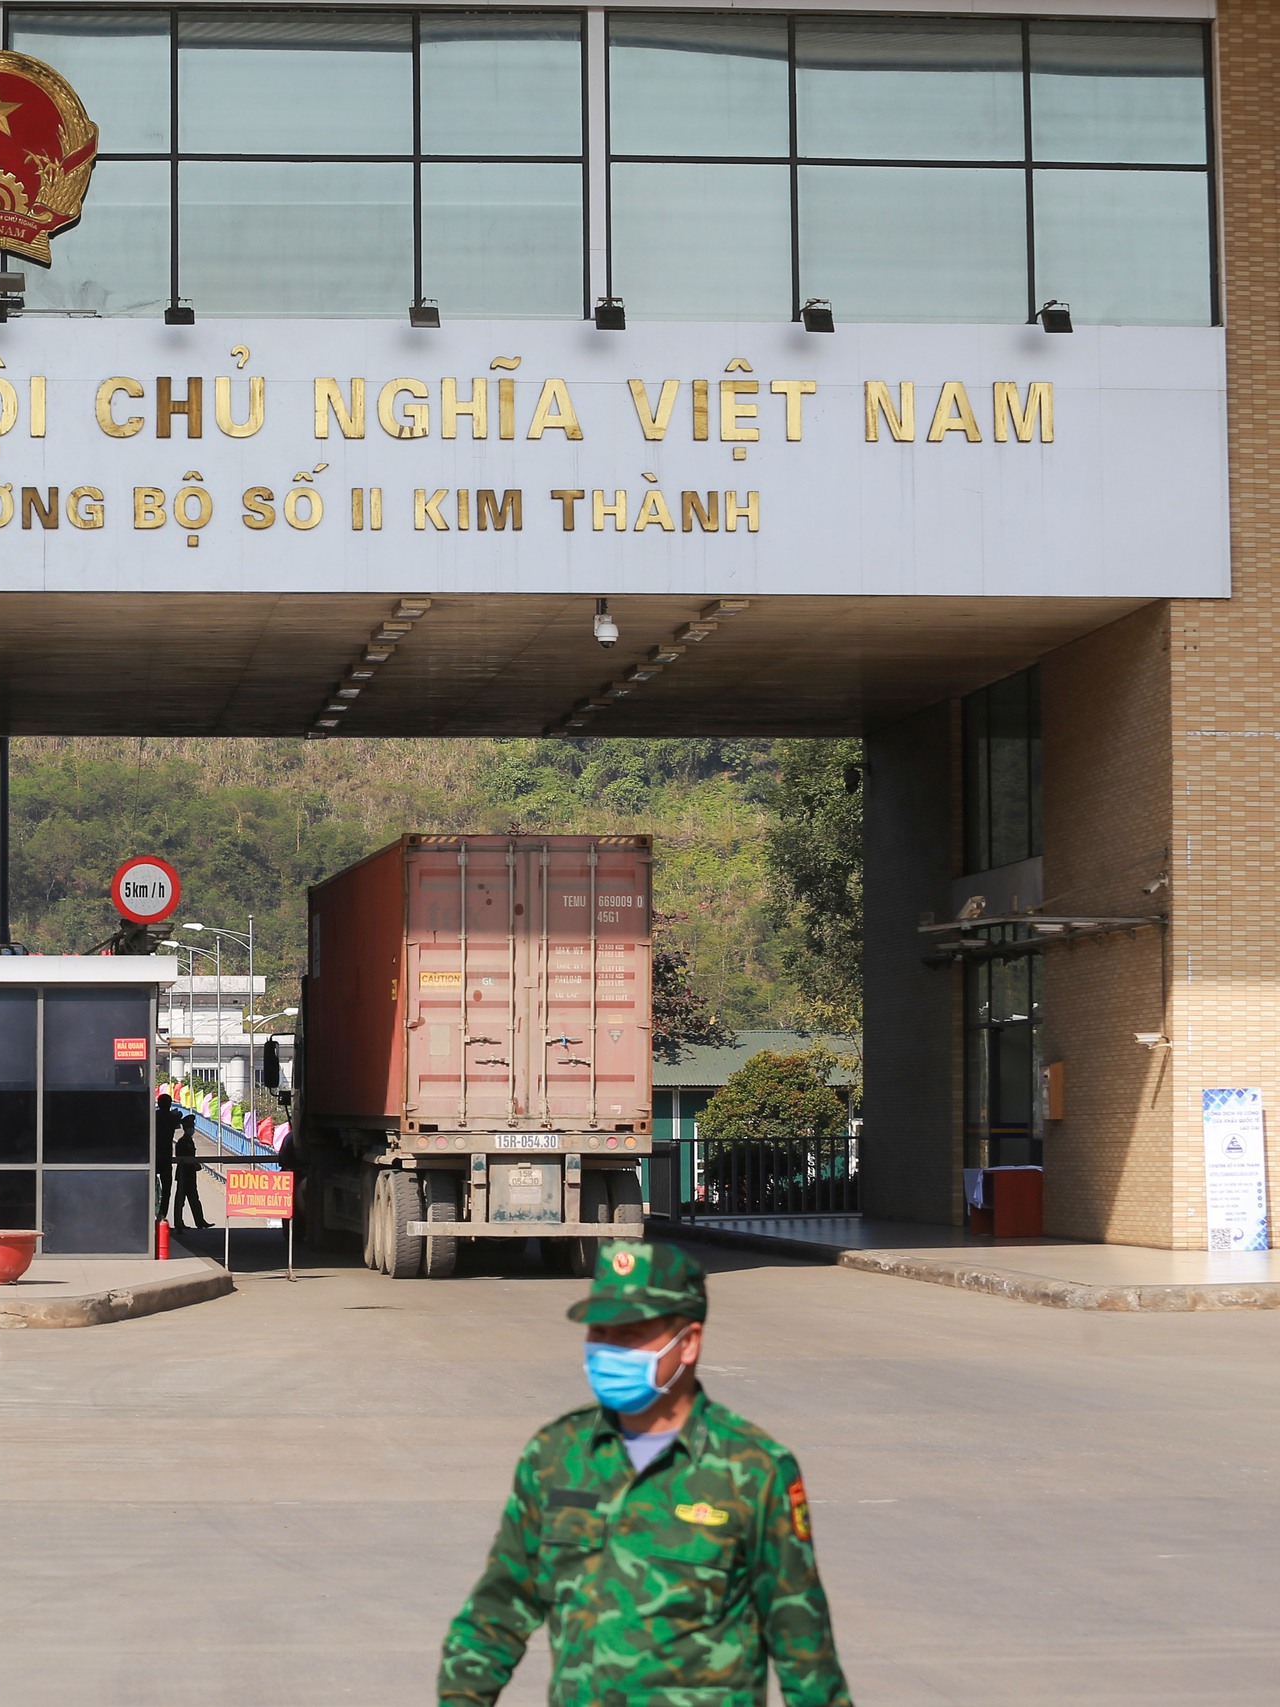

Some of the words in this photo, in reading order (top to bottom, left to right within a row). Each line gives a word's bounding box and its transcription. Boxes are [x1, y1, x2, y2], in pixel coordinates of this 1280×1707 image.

[96, 345, 266, 439] CHỦ
[315, 357, 584, 441] NGHĨA
[628, 358, 817, 460] VIỆT
[865, 381, 1055, 443] NAM
[134, 471, 213, 547] BỘ
[243, 464, 328, 530] SỐ
[415, 489, 523, 531] KIM
[552, 473, 760, 532] THÀNH
[563, 895, 586, 907] TEMU
[598, 895, 632, 907] 669009
[637, 895, 643, 908] 0
[597, 911, 619, 922] 45G1
[422, 975, 460, 983] CAUTION
[482, 977, 494, 985] GL
[555, 975, 582, 984] PAYLOAD
[497, 1135, 556, 1148] 15R-054.30
[230, 1170, 269, 1190] DỪNG
[272, 1175, 290, 1190] XE
[228, 1191, 245, 1205] XUẤT
[246, 1192, 266, 1206] TRÌNH
[267, 1192, 282, 1206] GIẤY
